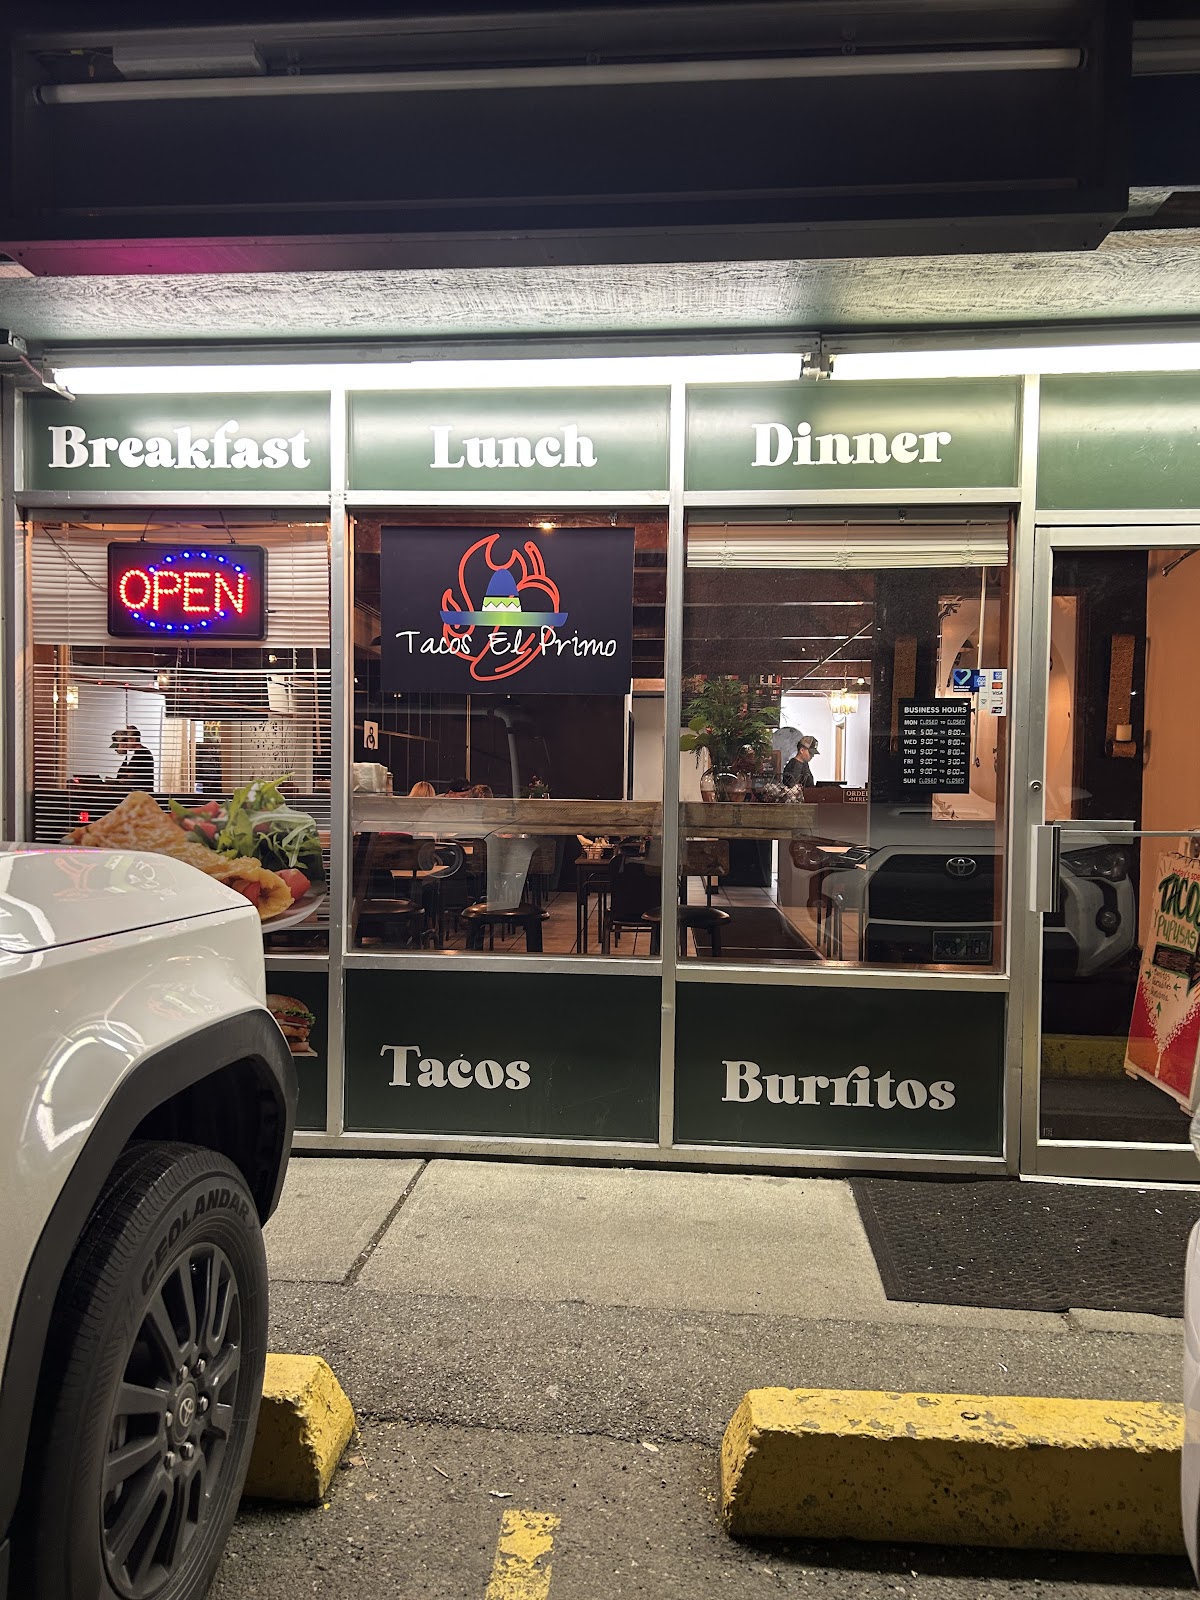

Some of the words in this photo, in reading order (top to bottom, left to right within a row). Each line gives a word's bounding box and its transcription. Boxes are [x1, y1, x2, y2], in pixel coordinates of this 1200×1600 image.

[48, 419, 311, 470] Breakfast
[429, 423, 597, 470] Lunch
[751, 421, 952, 469] Dinner
[119, 569, 245, 613] OPEN
[395, 630, 473, 655] Tacos
[488, 628, 525, 656] El
[538, 624, 618, 657] Primo
[1156, 914, 1197, 950] PUPUSAS
[380, 1044, 531, 1091] Tacos
[722, 1059, 957, 1111] Burritos
[142, 1188, 249, 1296] GEOLANDAR
